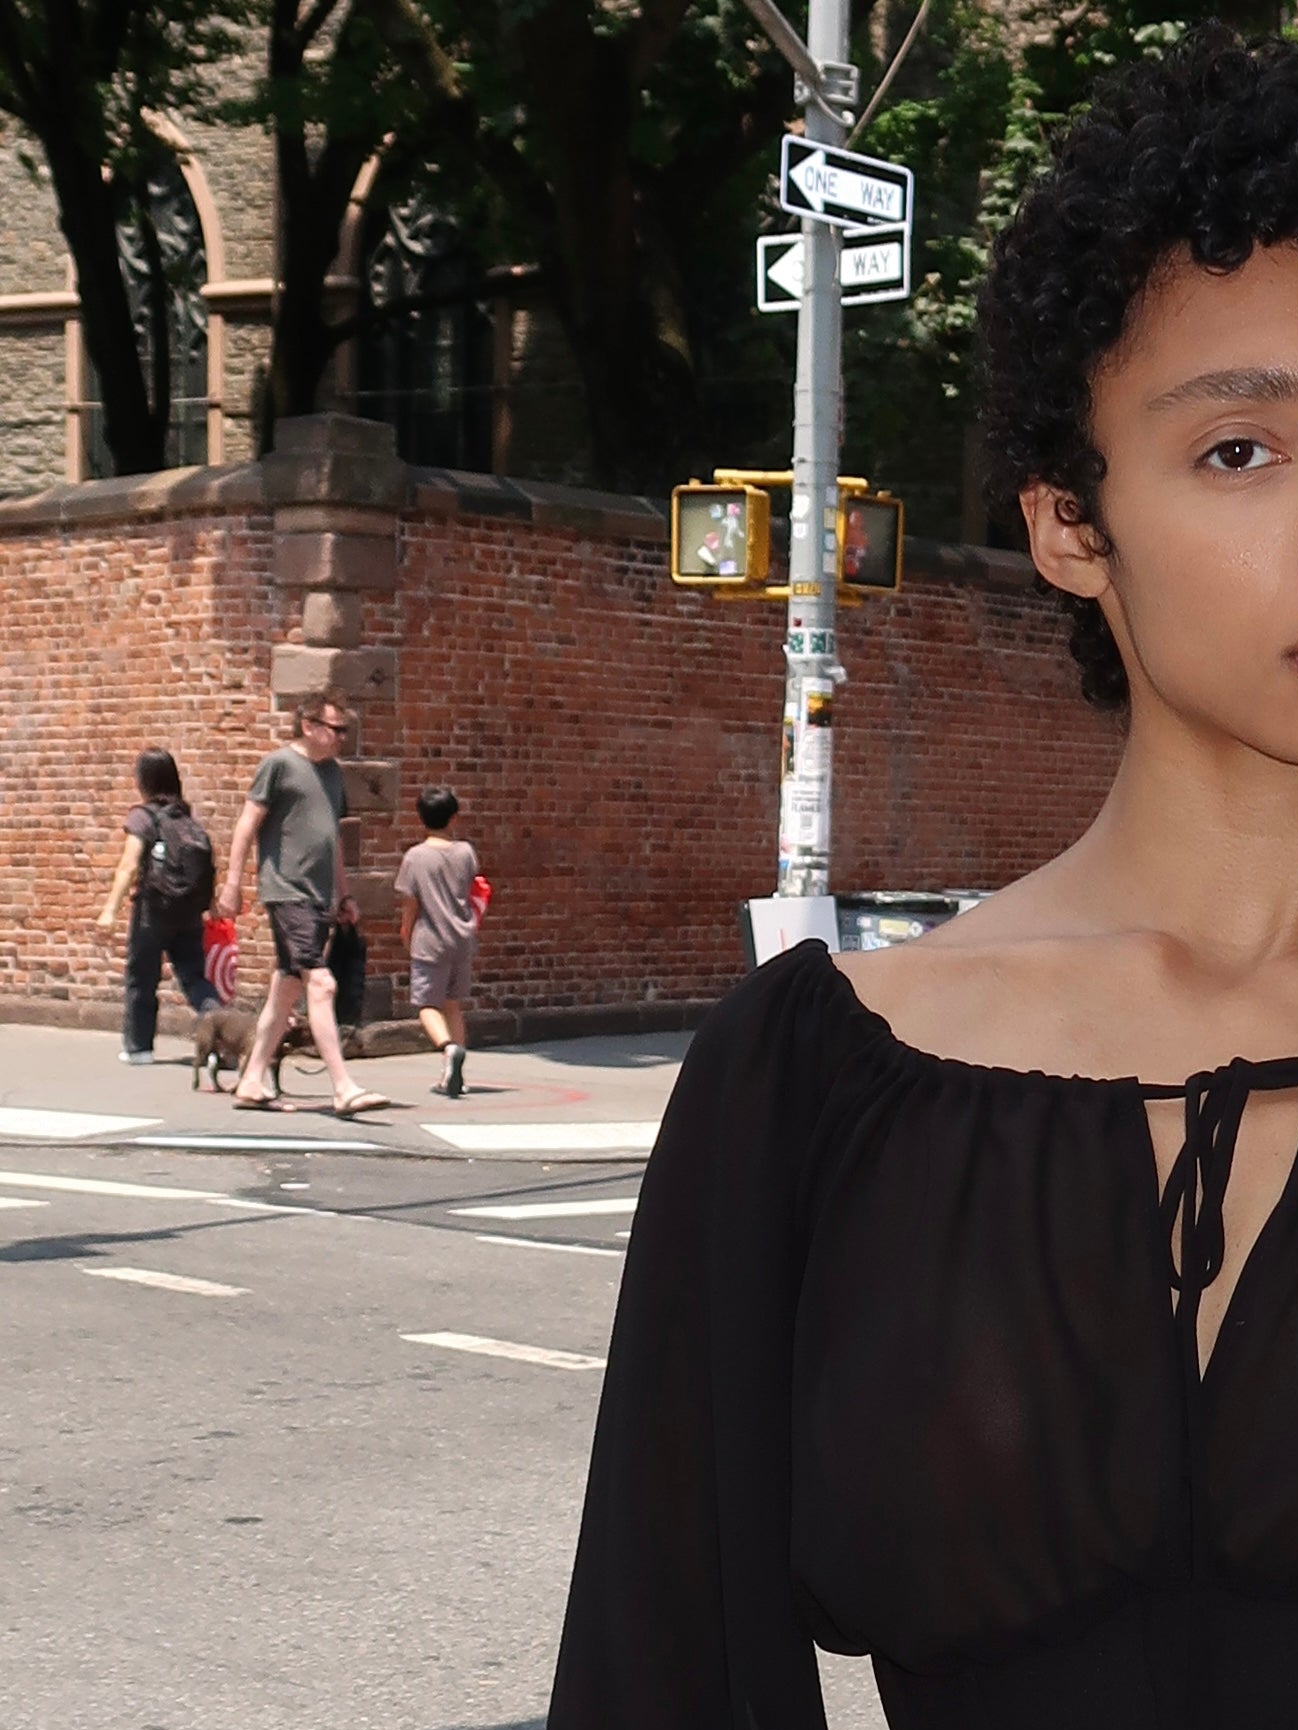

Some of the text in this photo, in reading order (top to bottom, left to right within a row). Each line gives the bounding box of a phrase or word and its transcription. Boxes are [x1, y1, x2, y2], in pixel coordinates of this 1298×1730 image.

[804, 166, 895, 211] ONE WAY
[853, 250, 890, 276] WAY
